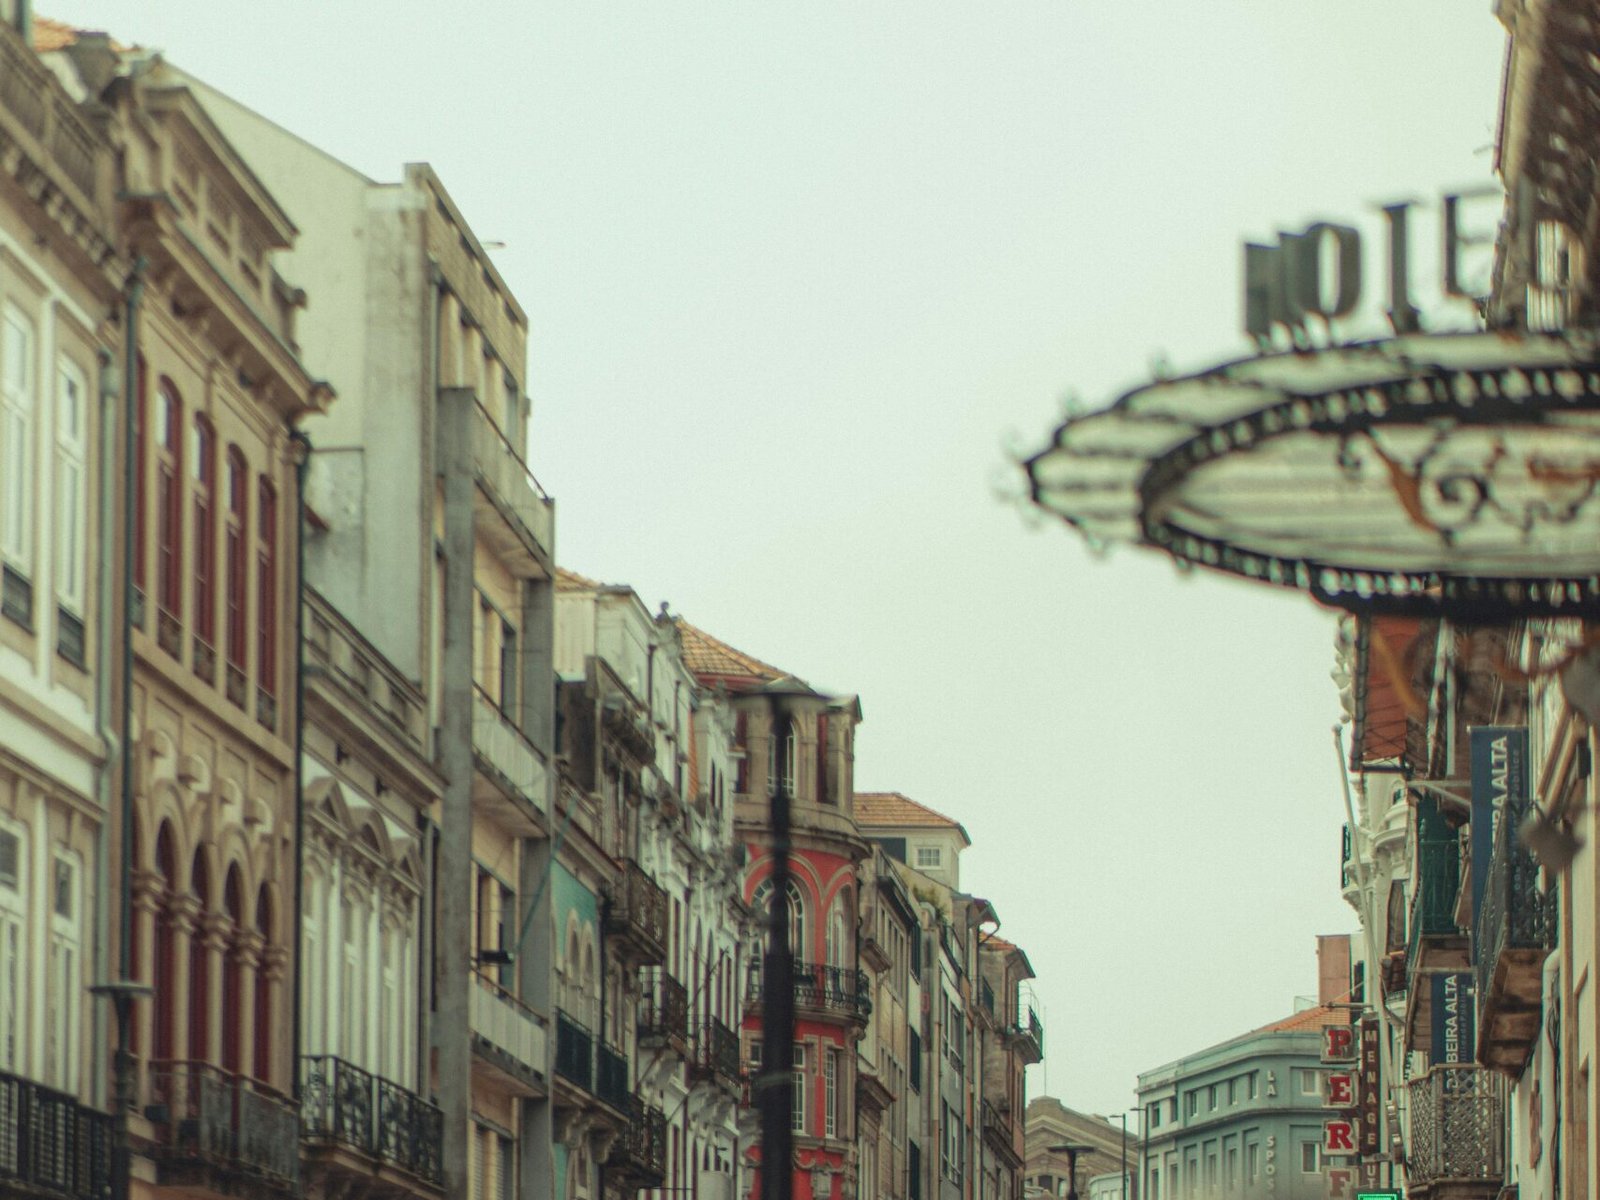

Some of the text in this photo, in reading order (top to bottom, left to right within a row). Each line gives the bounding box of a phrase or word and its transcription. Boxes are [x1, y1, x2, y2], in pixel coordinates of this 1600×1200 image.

[1491, 736, 1507, 789] ALTA
[1444, 974, 1457, 1015] ALTA
[1445, 1016, 1458, 1063] BEIRA
[1266, 1071, 1276, 1096] LA
[1364, 1030, 1378, 1145] MENAGE
